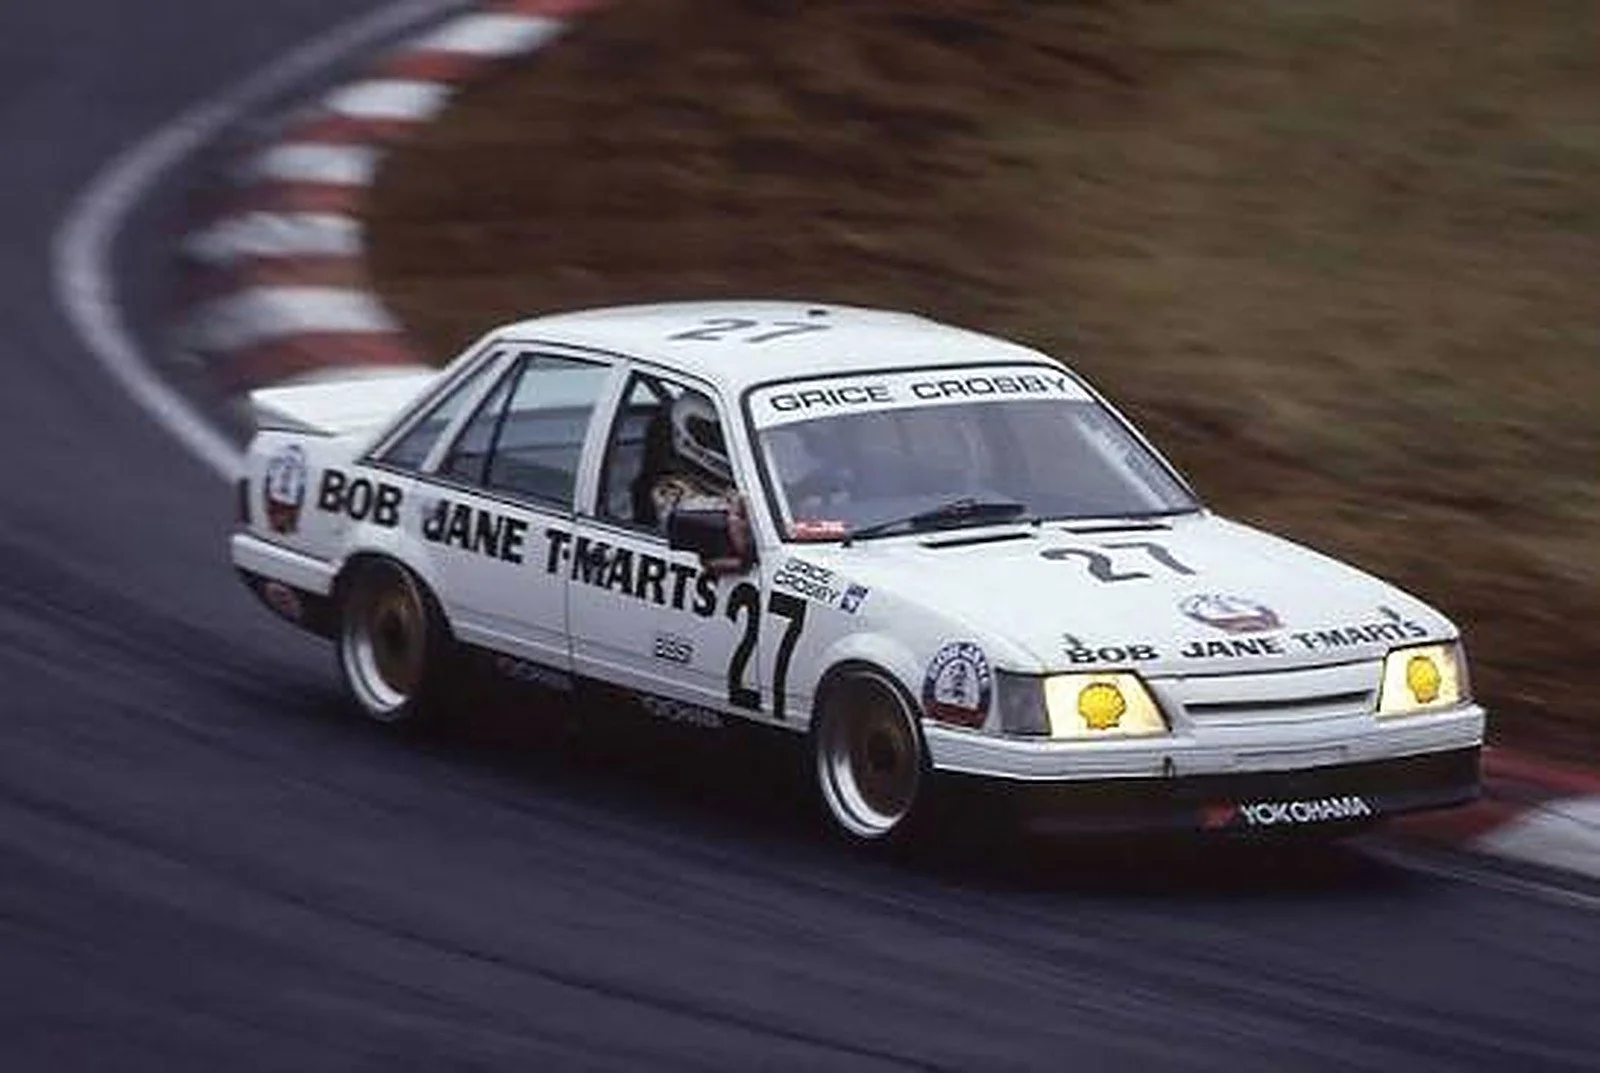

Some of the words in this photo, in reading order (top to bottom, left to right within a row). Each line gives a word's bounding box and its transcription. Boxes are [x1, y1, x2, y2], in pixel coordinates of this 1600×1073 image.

[667, 319, 832, 343] 27
[769, 385, 893, 411] GRICE
[911, 375, 1066, 399] CROSBY
[318, 469, 403, 528] BOB
[422, 499, 528, 563] JANE
[1040, 542, 1196, 583] 27
[726, 583, 807, 720] 27
[1066, 645, 1159, 663] BOB
[1181, 638, 1283, 658] JANE
[1240, 796, 1372, 824] YOKOHAMA
